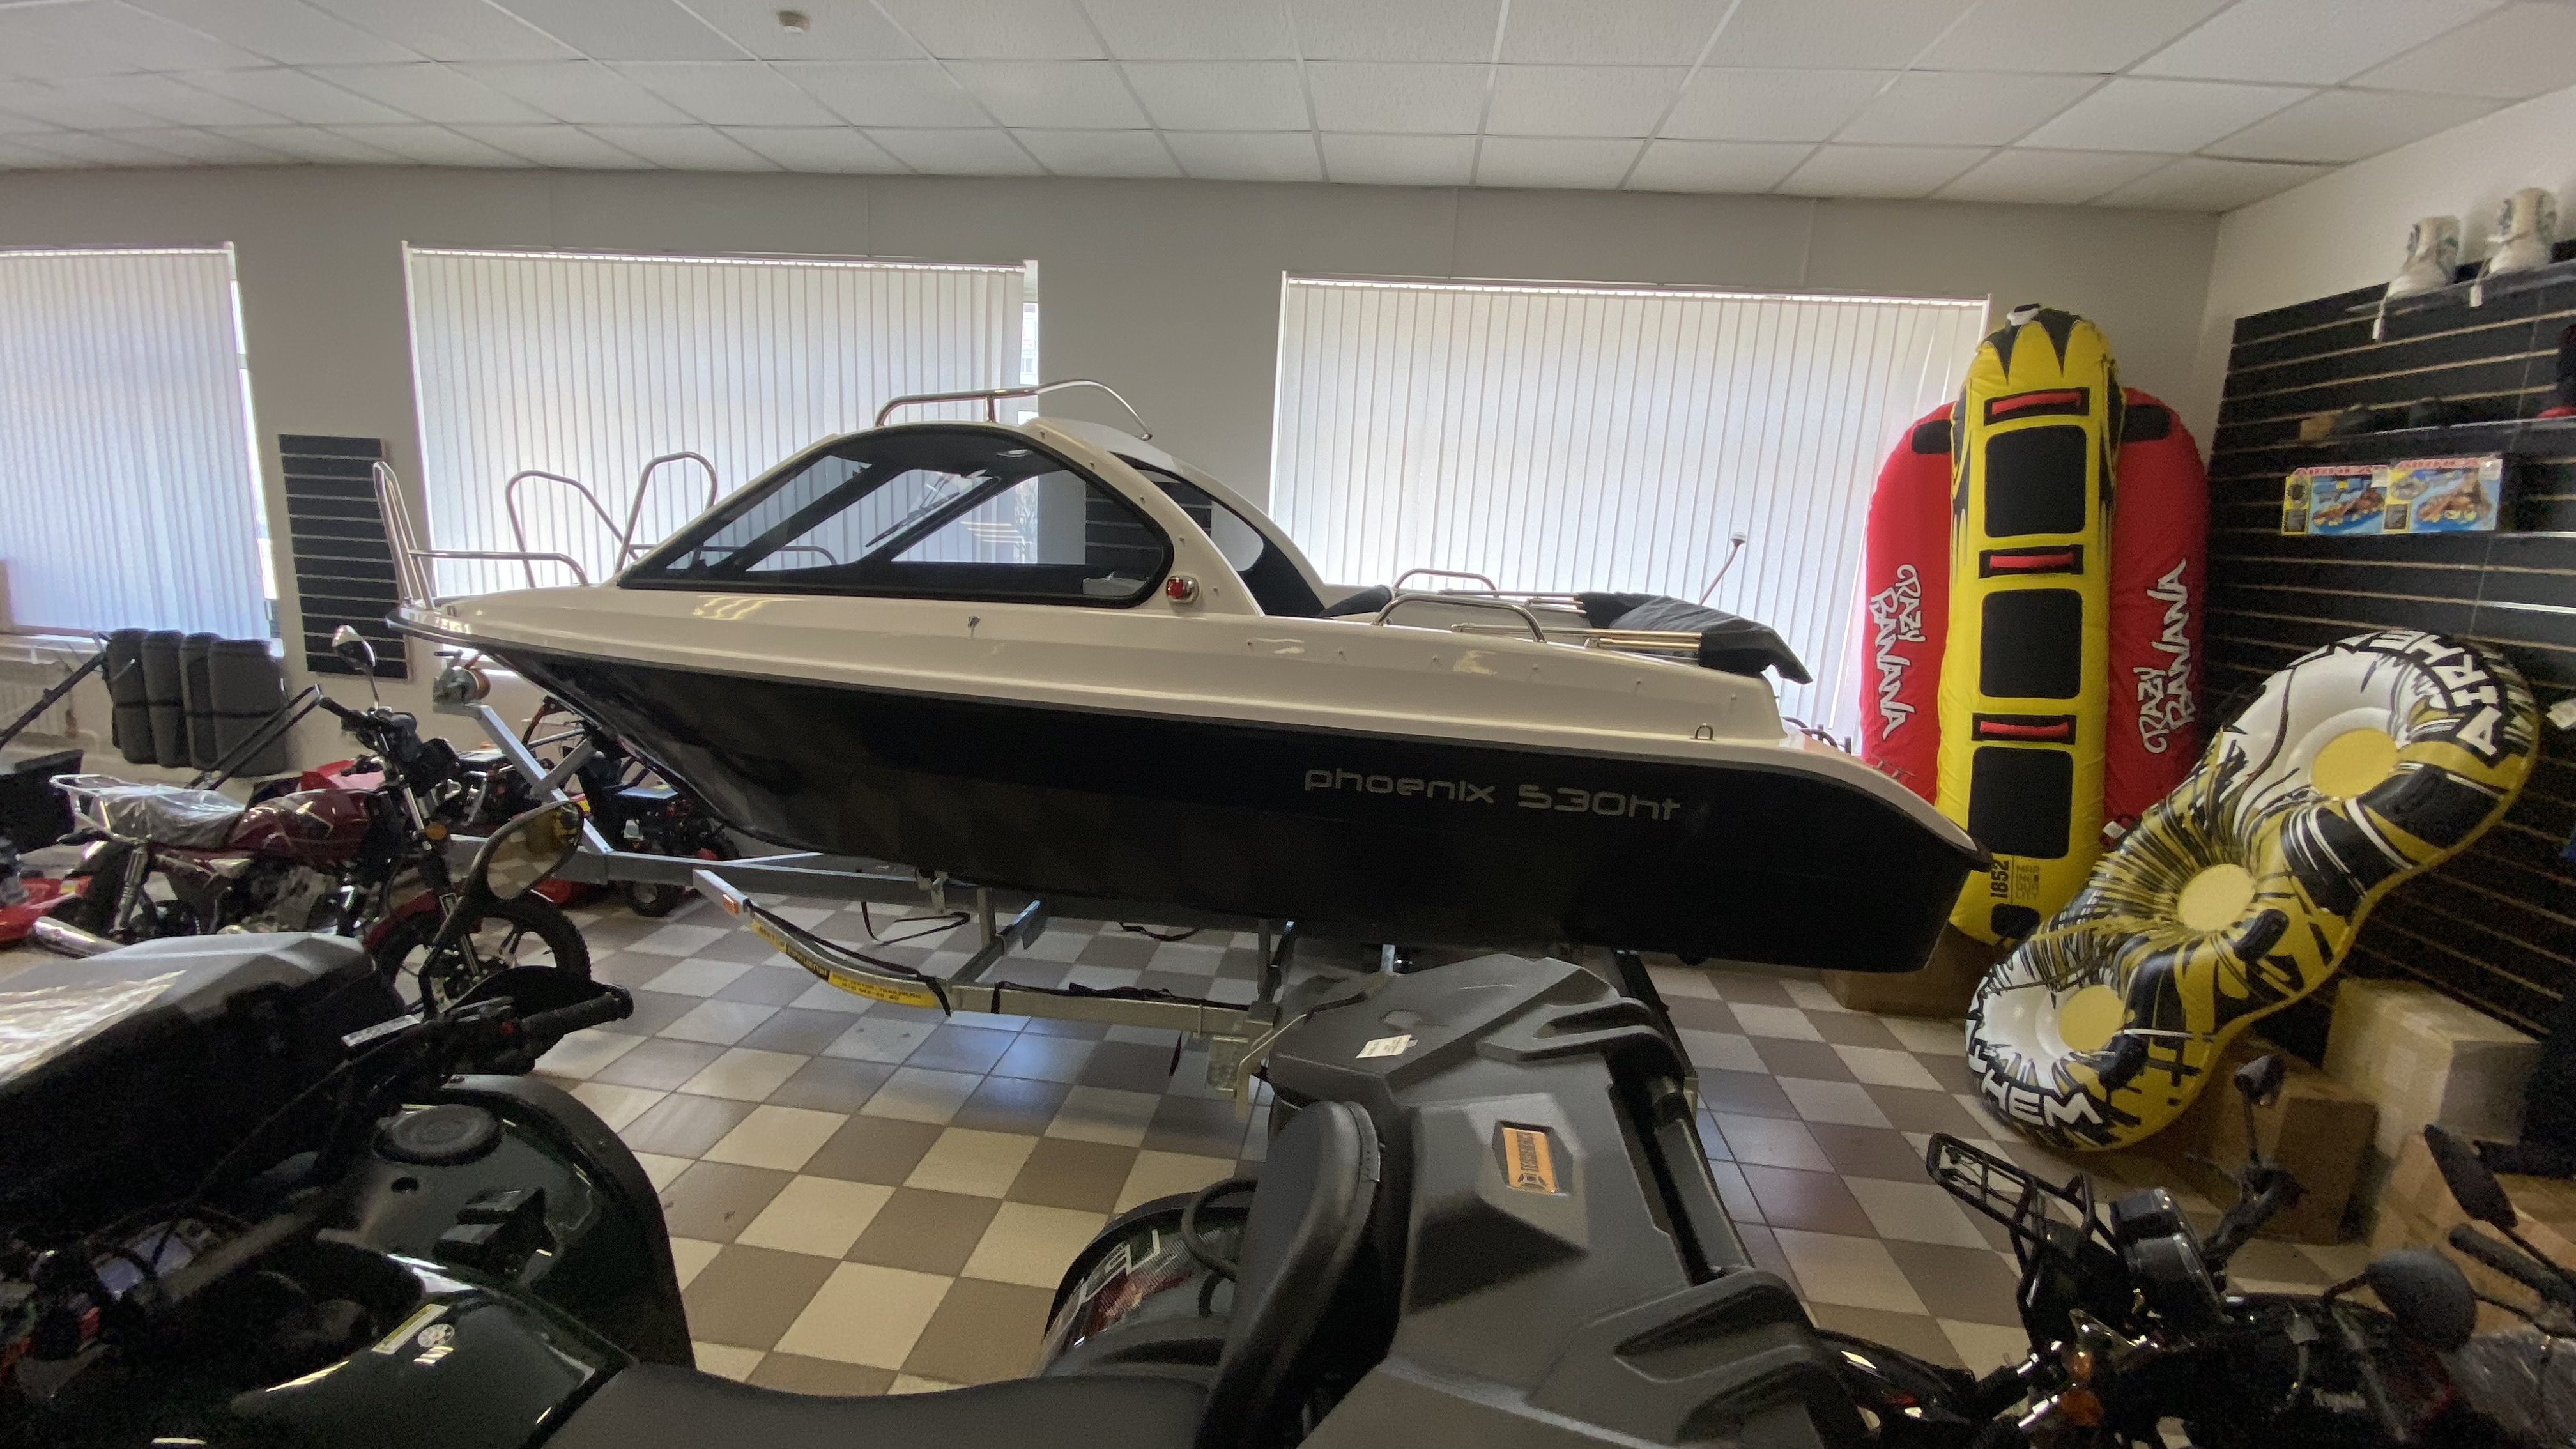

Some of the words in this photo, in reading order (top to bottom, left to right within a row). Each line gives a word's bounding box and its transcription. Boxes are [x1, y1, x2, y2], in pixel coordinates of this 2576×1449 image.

[1895, 564, 1926, 642] CRAZY
[2146, 557, 2197, 731] BANANA
[1869, 586, 1916, 741] BANANA
[2133, 666, 2170, 753] CRAZY
[1304, 767, 1496, 804] phoenix
[1517, 783, 1682, 821] 530ht
[1990, 859, 2009, 899] 1852
